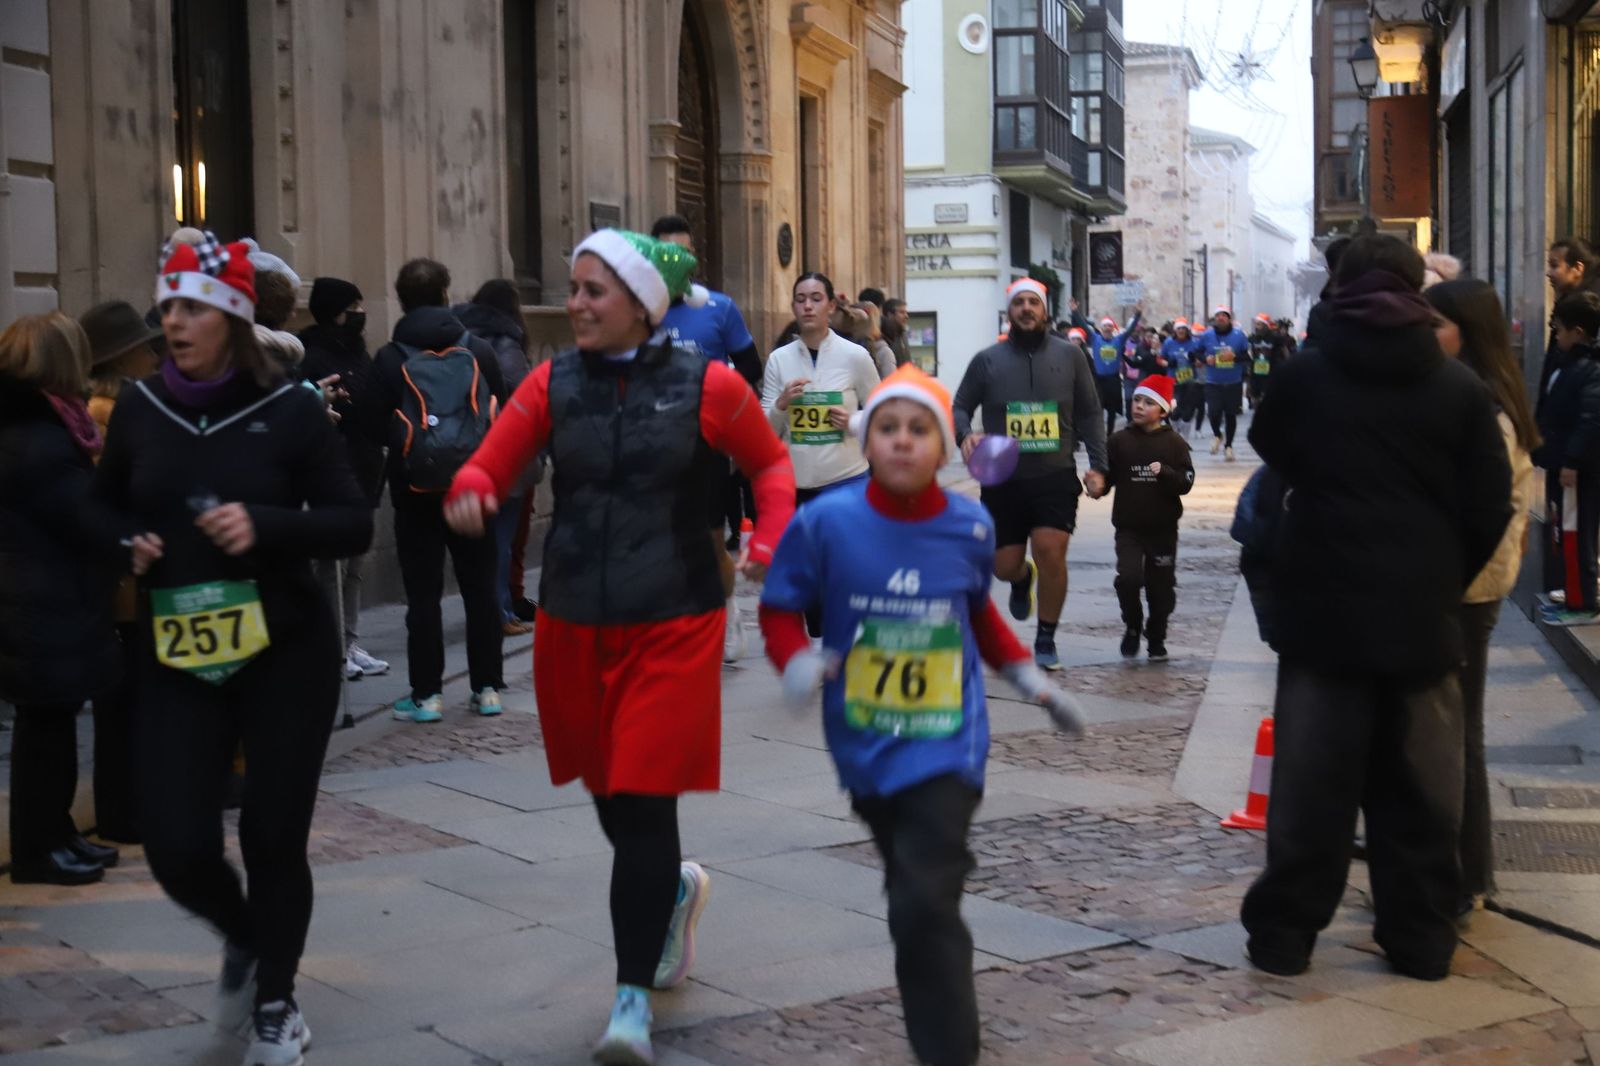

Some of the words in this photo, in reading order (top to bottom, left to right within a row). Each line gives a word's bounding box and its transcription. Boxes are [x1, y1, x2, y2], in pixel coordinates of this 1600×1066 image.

[793, 407, 833, 429] 294
[1010, 418, 1051, 438] 944
[887, 568, 920, 596] 46
[162, 609, 243, 658] 257
[870, 653, 926, 701] 76
